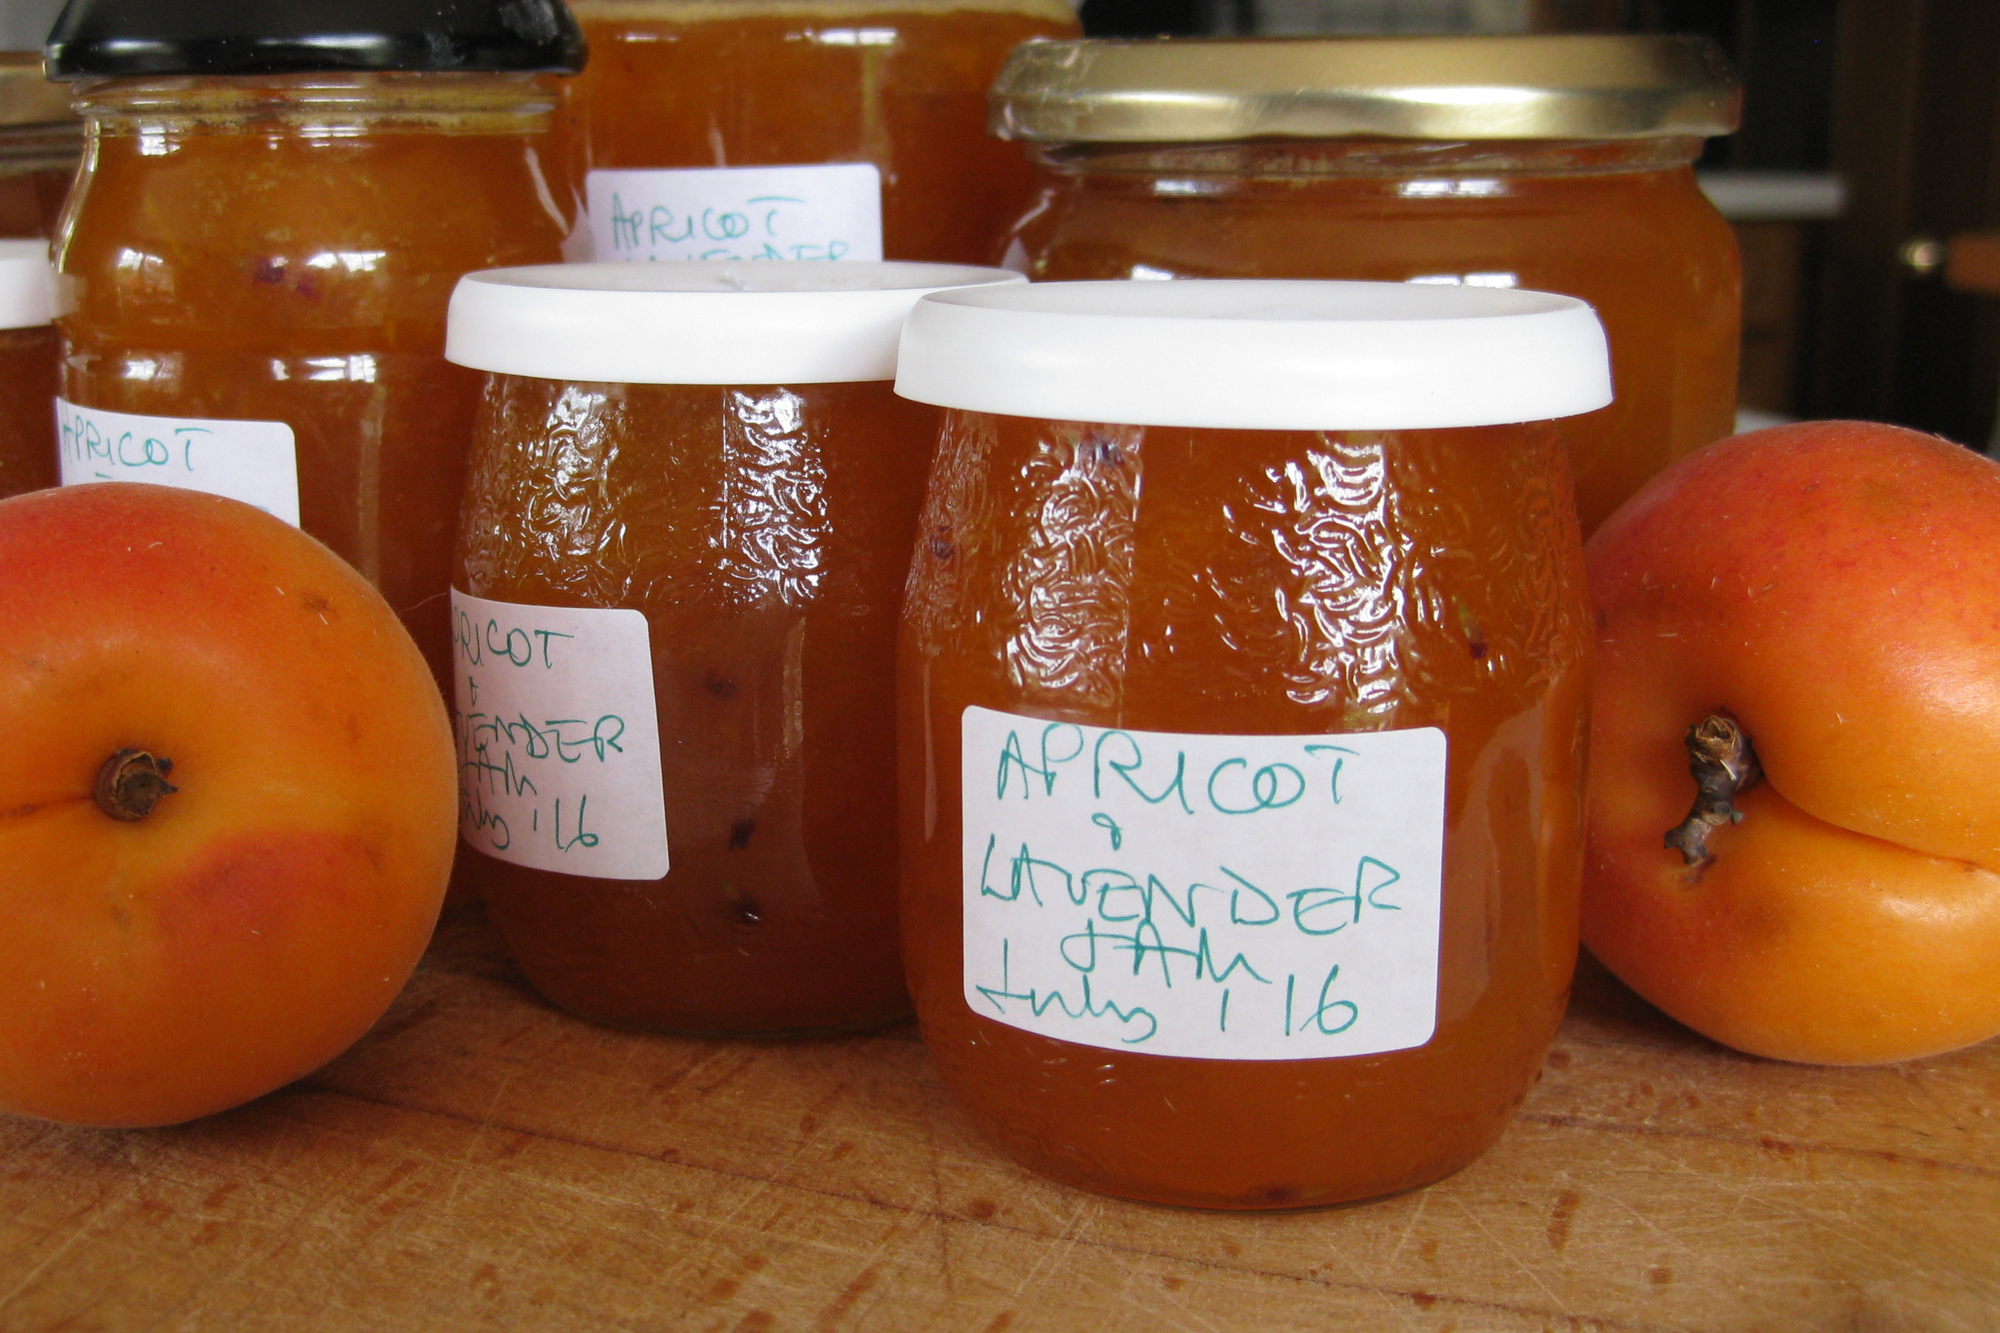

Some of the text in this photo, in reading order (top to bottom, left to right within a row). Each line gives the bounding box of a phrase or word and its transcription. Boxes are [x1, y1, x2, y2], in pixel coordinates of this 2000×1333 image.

[611, 191, 807, 251] APRICOT
[453, 605, 576, 669] PRICOT
[456, 711, 626, 763] VENDER
[998, 722, 1361, 815] APRICOT
[981, 833, 1402, 936] LAVENDER
[1060, 917, 1273, 989] JAM
[976, 937, 1158, 1043] July
